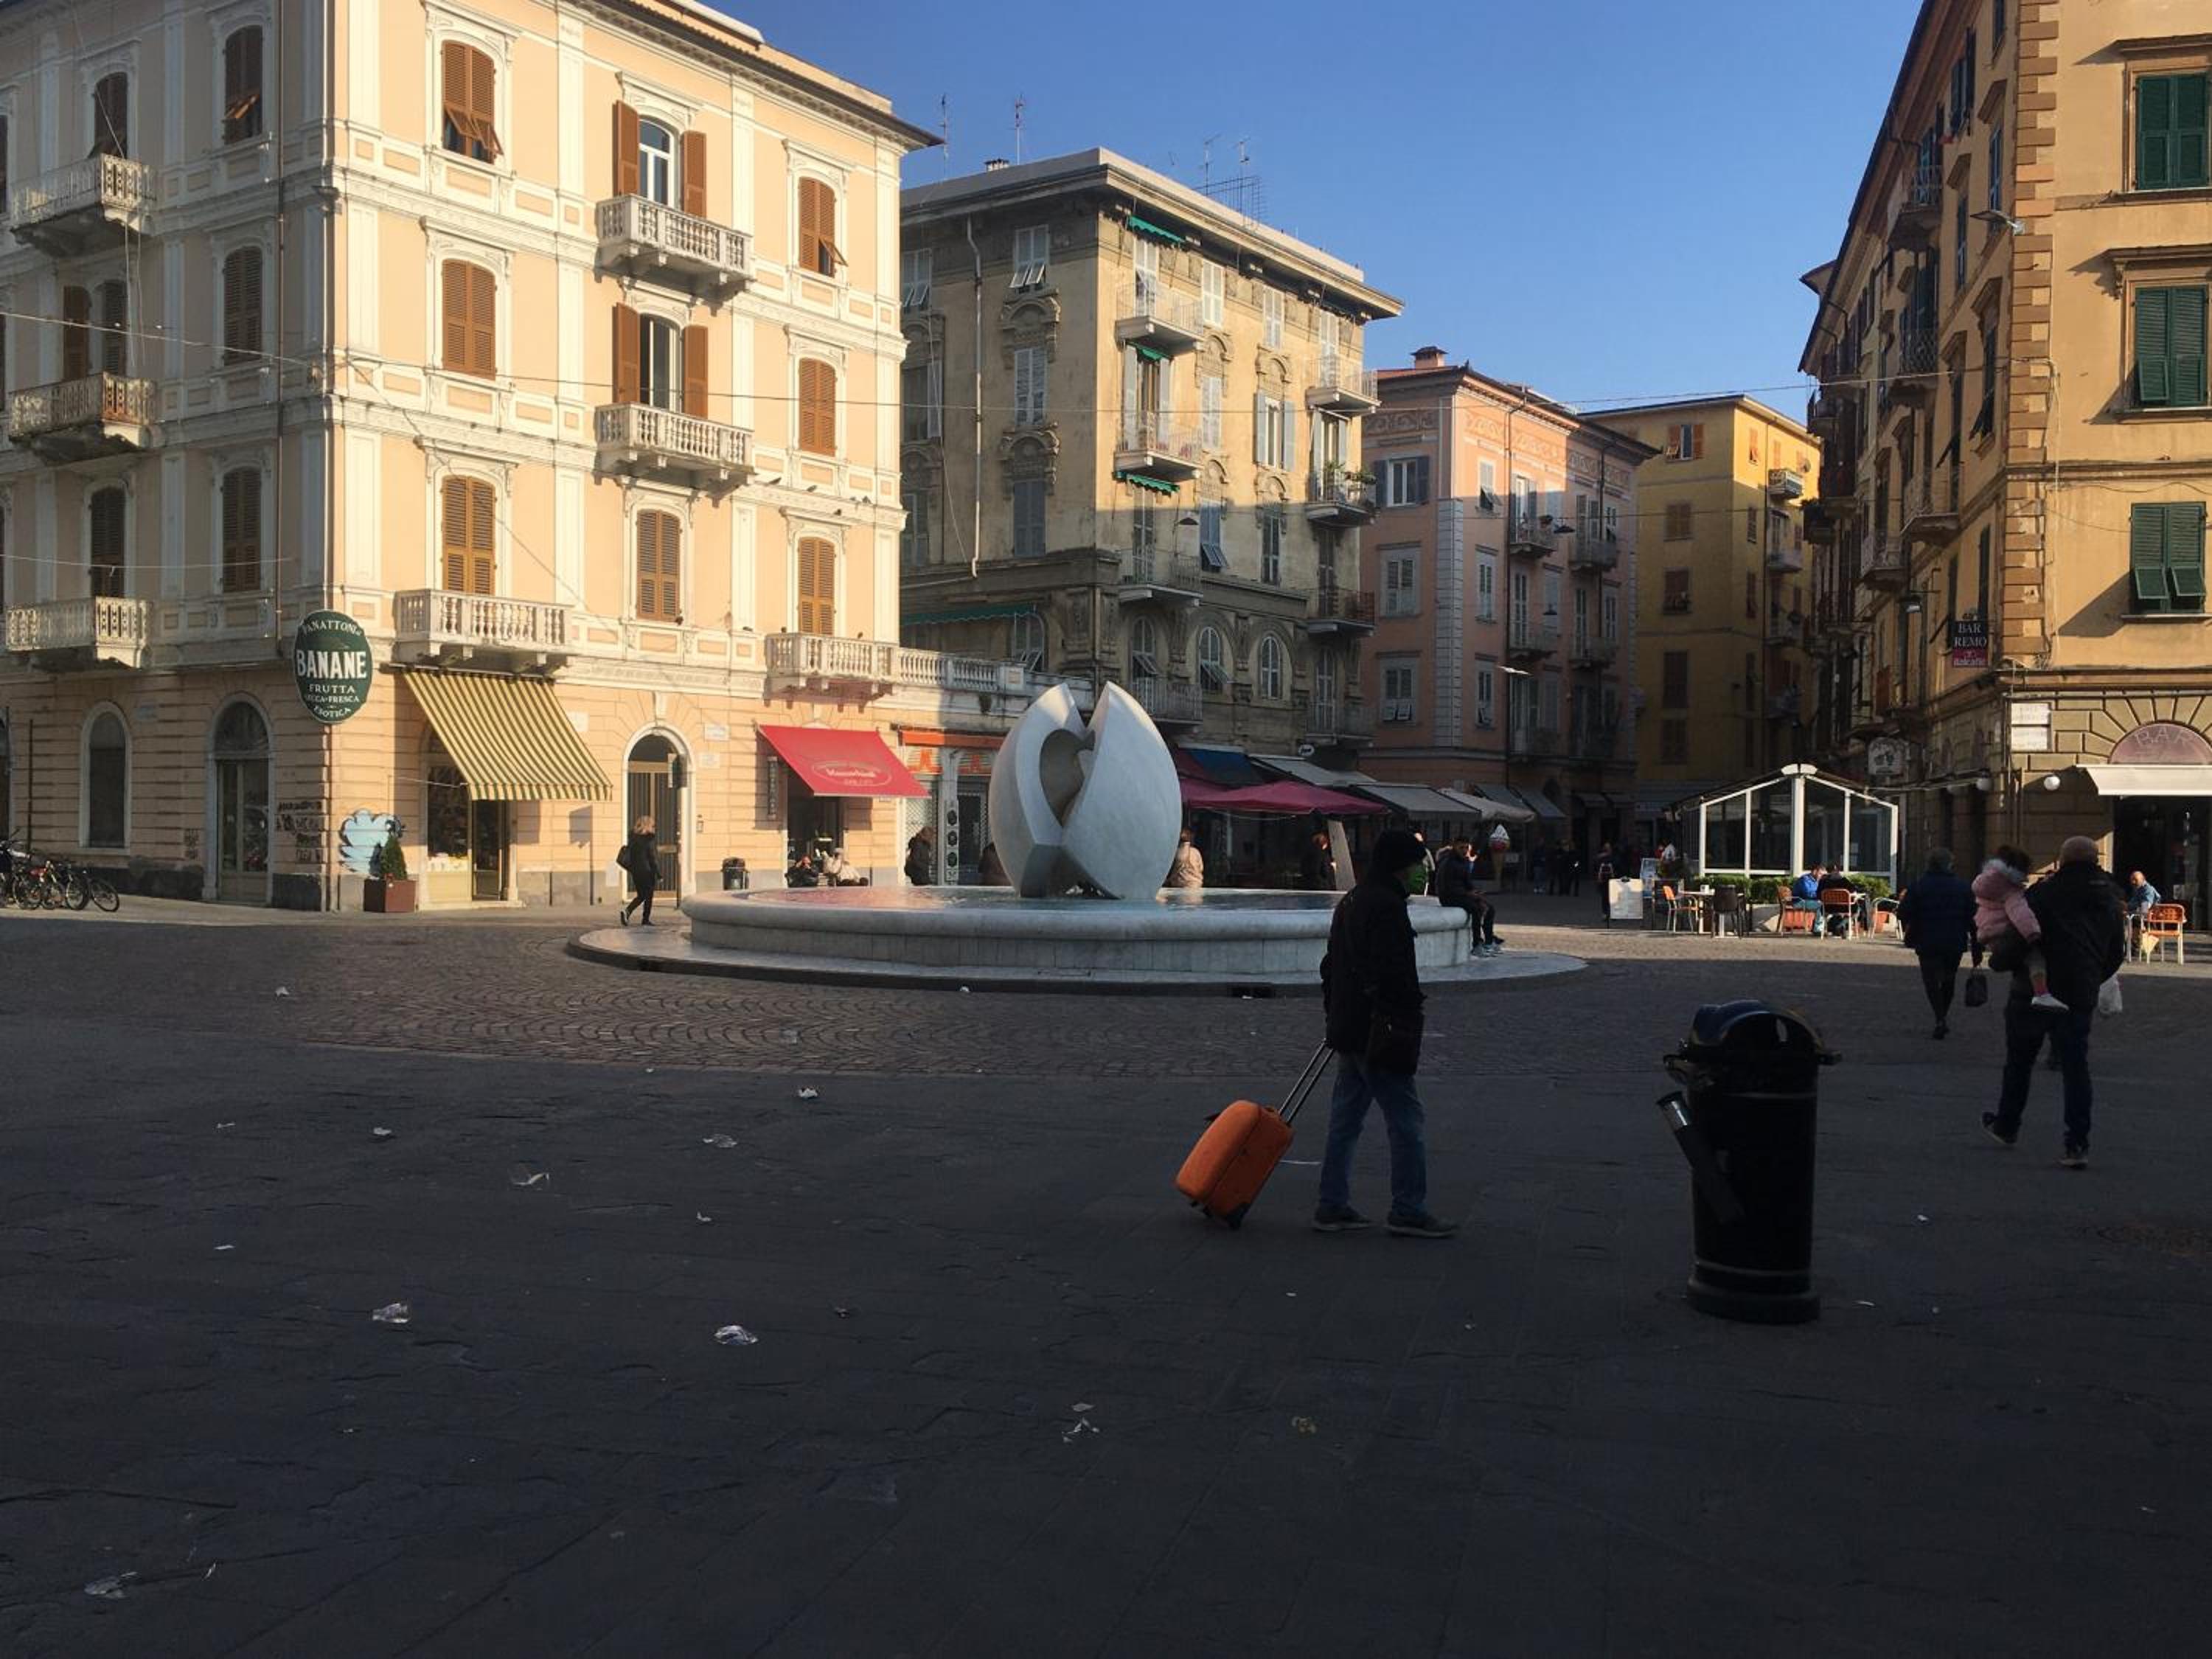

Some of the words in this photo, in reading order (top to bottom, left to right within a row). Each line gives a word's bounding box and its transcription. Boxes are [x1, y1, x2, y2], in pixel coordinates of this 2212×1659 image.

[1958, 622, 1982, 633] BAR
[1954, 636, 1987, 647] REMO
[296, 650, 366, 679] BANANE
[309, 684, 356, 694] FRUTTA
